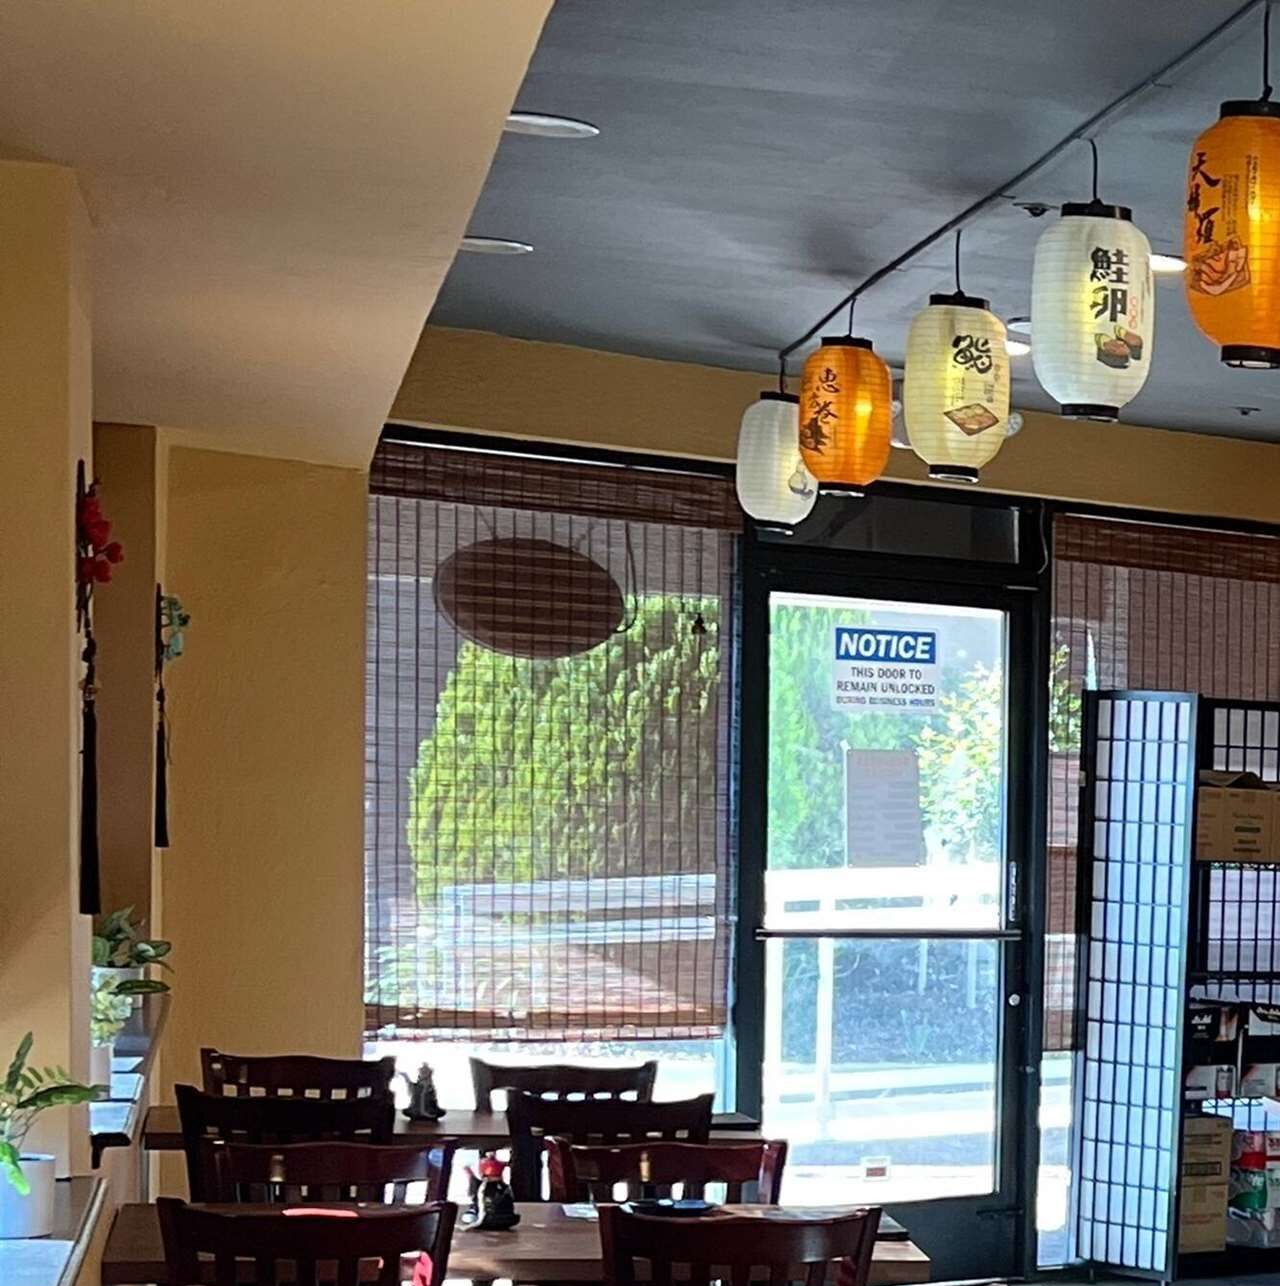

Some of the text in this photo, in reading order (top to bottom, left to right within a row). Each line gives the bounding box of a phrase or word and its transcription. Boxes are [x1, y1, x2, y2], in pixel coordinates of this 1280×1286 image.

[1090, 246, 1129, 322] 鮭卵
[839, 632, 932, 660] NOTICE
[851, 666, 923, 681] THIS DOOR TO
[836, 680, 935, 696] REMAIN UNLOCKED
